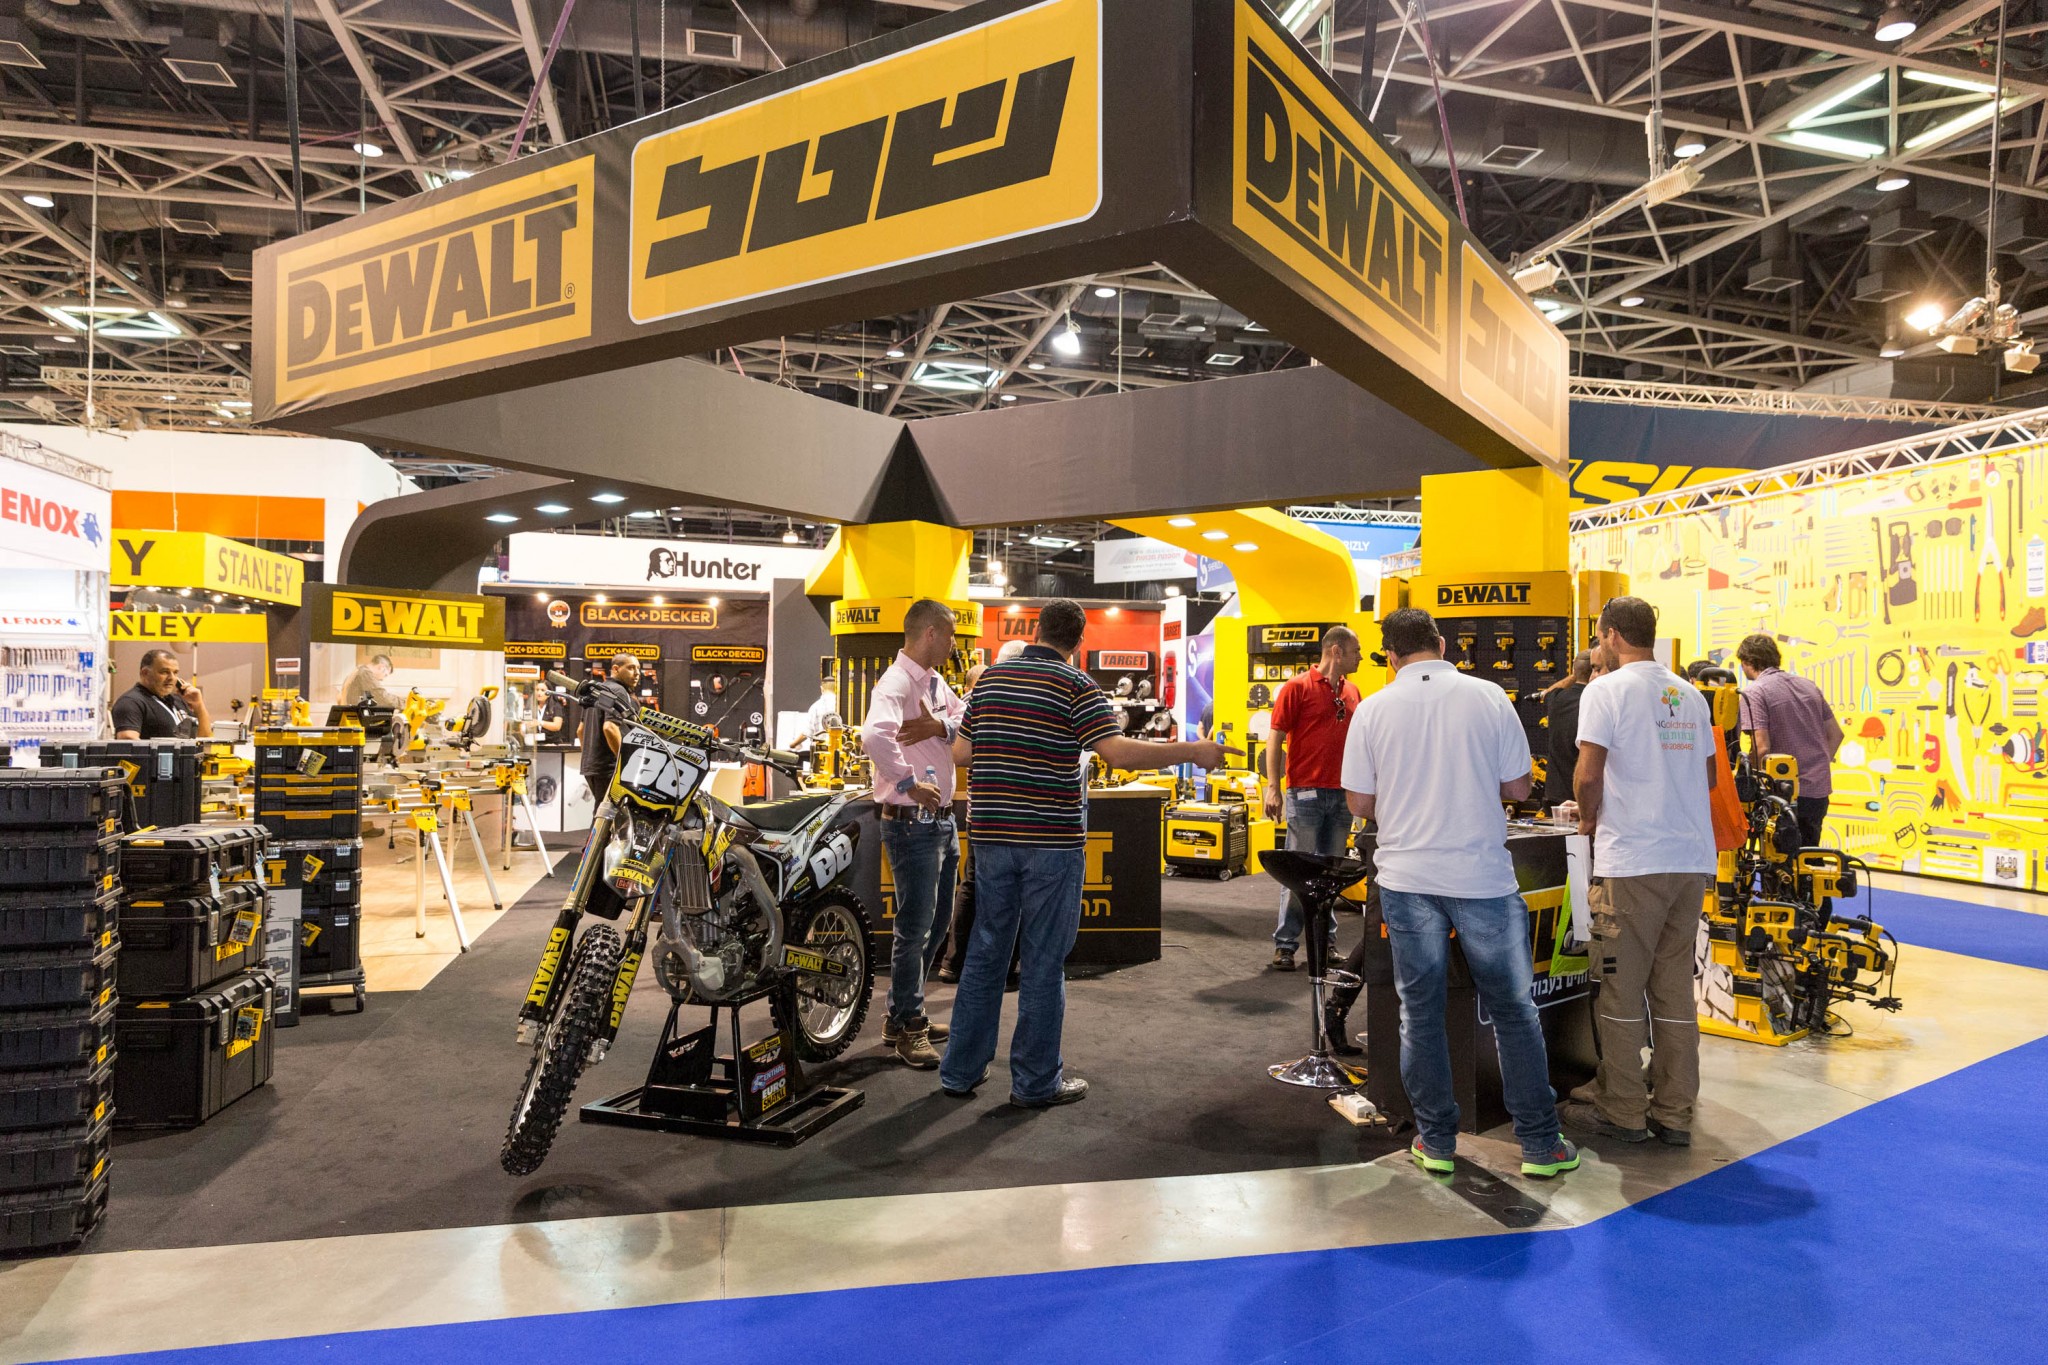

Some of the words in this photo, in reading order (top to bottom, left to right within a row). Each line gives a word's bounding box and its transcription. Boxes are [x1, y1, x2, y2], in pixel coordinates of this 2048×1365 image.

[0, 487, 80, 538] ENOX
[218, 547, 293, 596] STANLEY
[676, 551, 762, 581] Hunter
[1437, 585, 1531, 605] DEWALT
[2, 617, 63, 625] LENOX
[332, 597, 484, 638] DEWALT
[586, 608, 711, 624] BLACK+DECKER
[836, 608, 881, 624] DEWALT
[112, 614, 203, 637] NLEY
[504, 646, 562, 654] ACK+DECKER
[588, 647, 657, 656] BLACK+DECKER
[695, 648, 762, 659] BLACK+DECKER
[1103, 653, 1146, 665] TARGET
[762, 1077, 786, 1099] EURO
